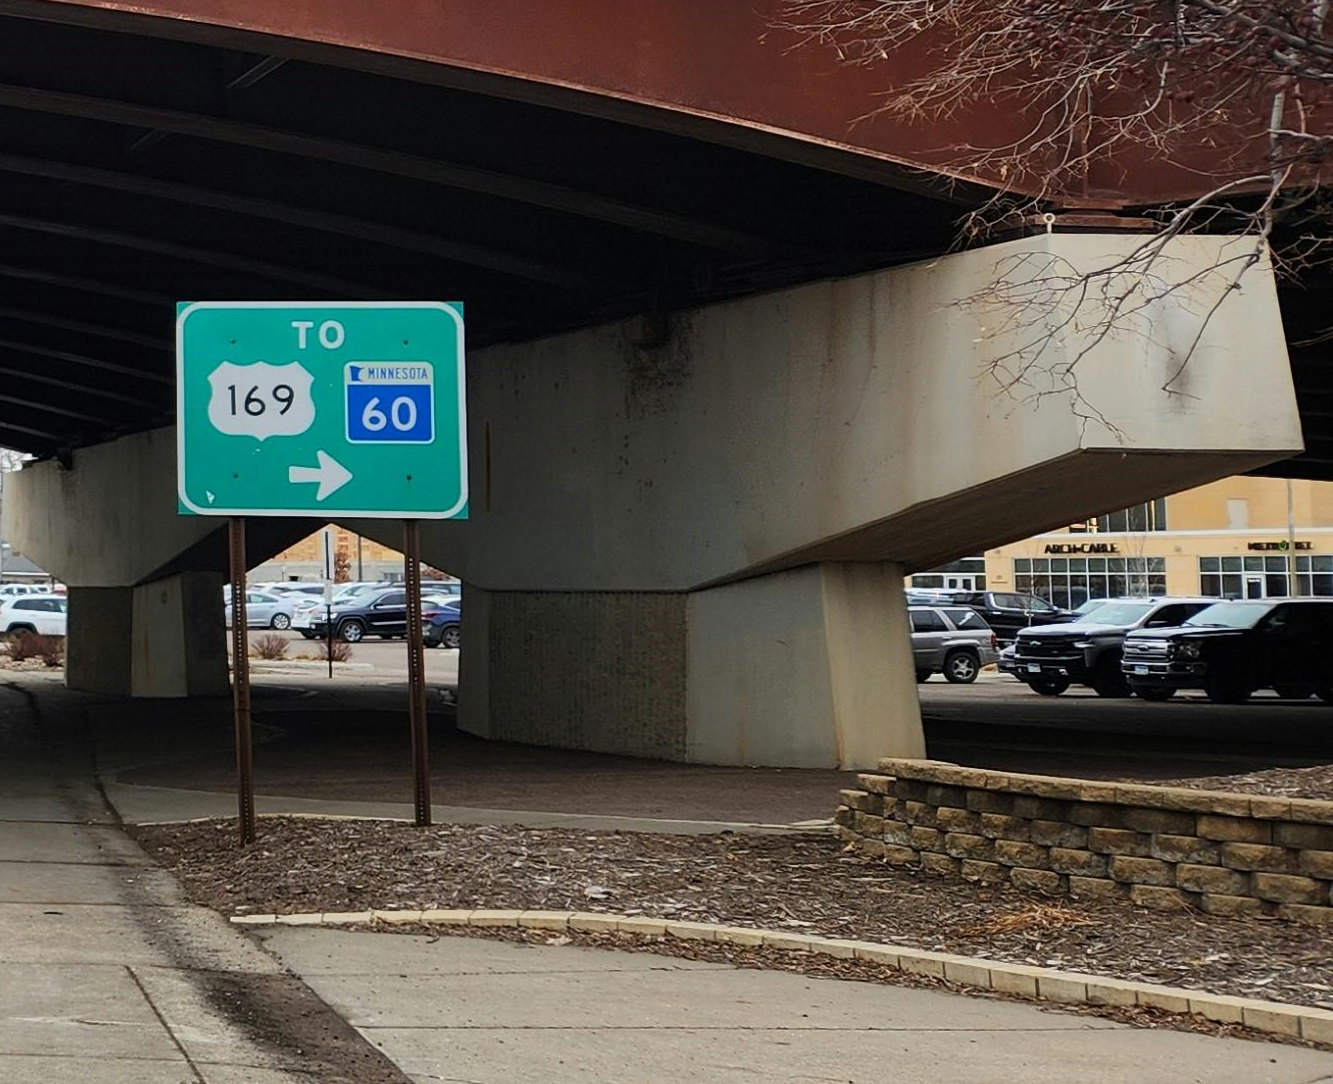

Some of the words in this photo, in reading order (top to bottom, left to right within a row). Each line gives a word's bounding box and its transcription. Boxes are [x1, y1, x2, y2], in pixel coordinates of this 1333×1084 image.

[291, 320, 345, 349] TO
[367, 367, 428, 380] MINNESOTA
[227, 384, 295, 416] 169
[361, 396, 418, 432] 60
